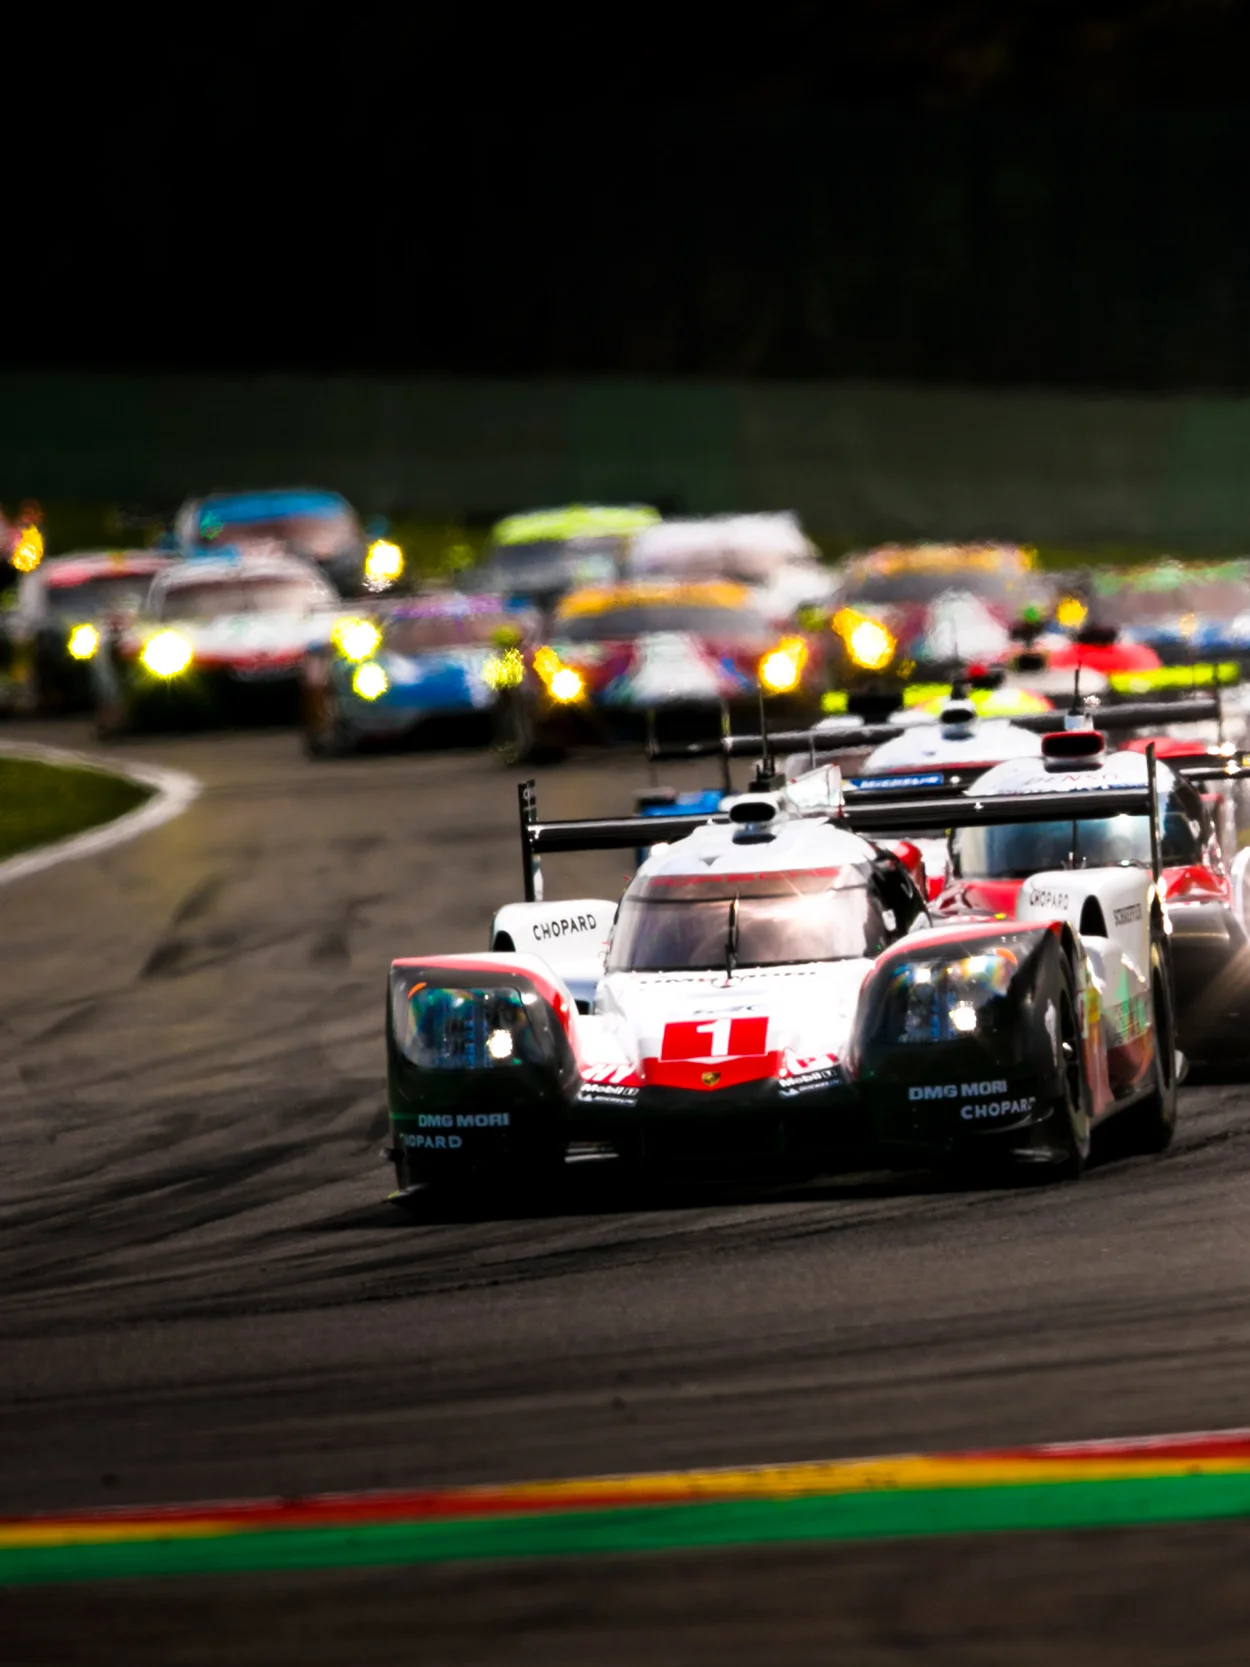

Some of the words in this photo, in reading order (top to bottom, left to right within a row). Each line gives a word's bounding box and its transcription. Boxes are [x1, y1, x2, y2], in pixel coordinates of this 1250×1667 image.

[532, 914, 597, 941] CHOPARD
[696, 1018, 732, 1057] 1
[779, 1070, 822, 1088] Mobil
[580, 1083, 624, 1096] Mobil
[908, 1085, 958, 1101] DMG
[961, 1080, 1008, 1097] MORI
[418, 1114, 453, 1128] DMG
[456, 1112, 511, 1127] MORI
[402, 1134, 463, 1149] OPARD
